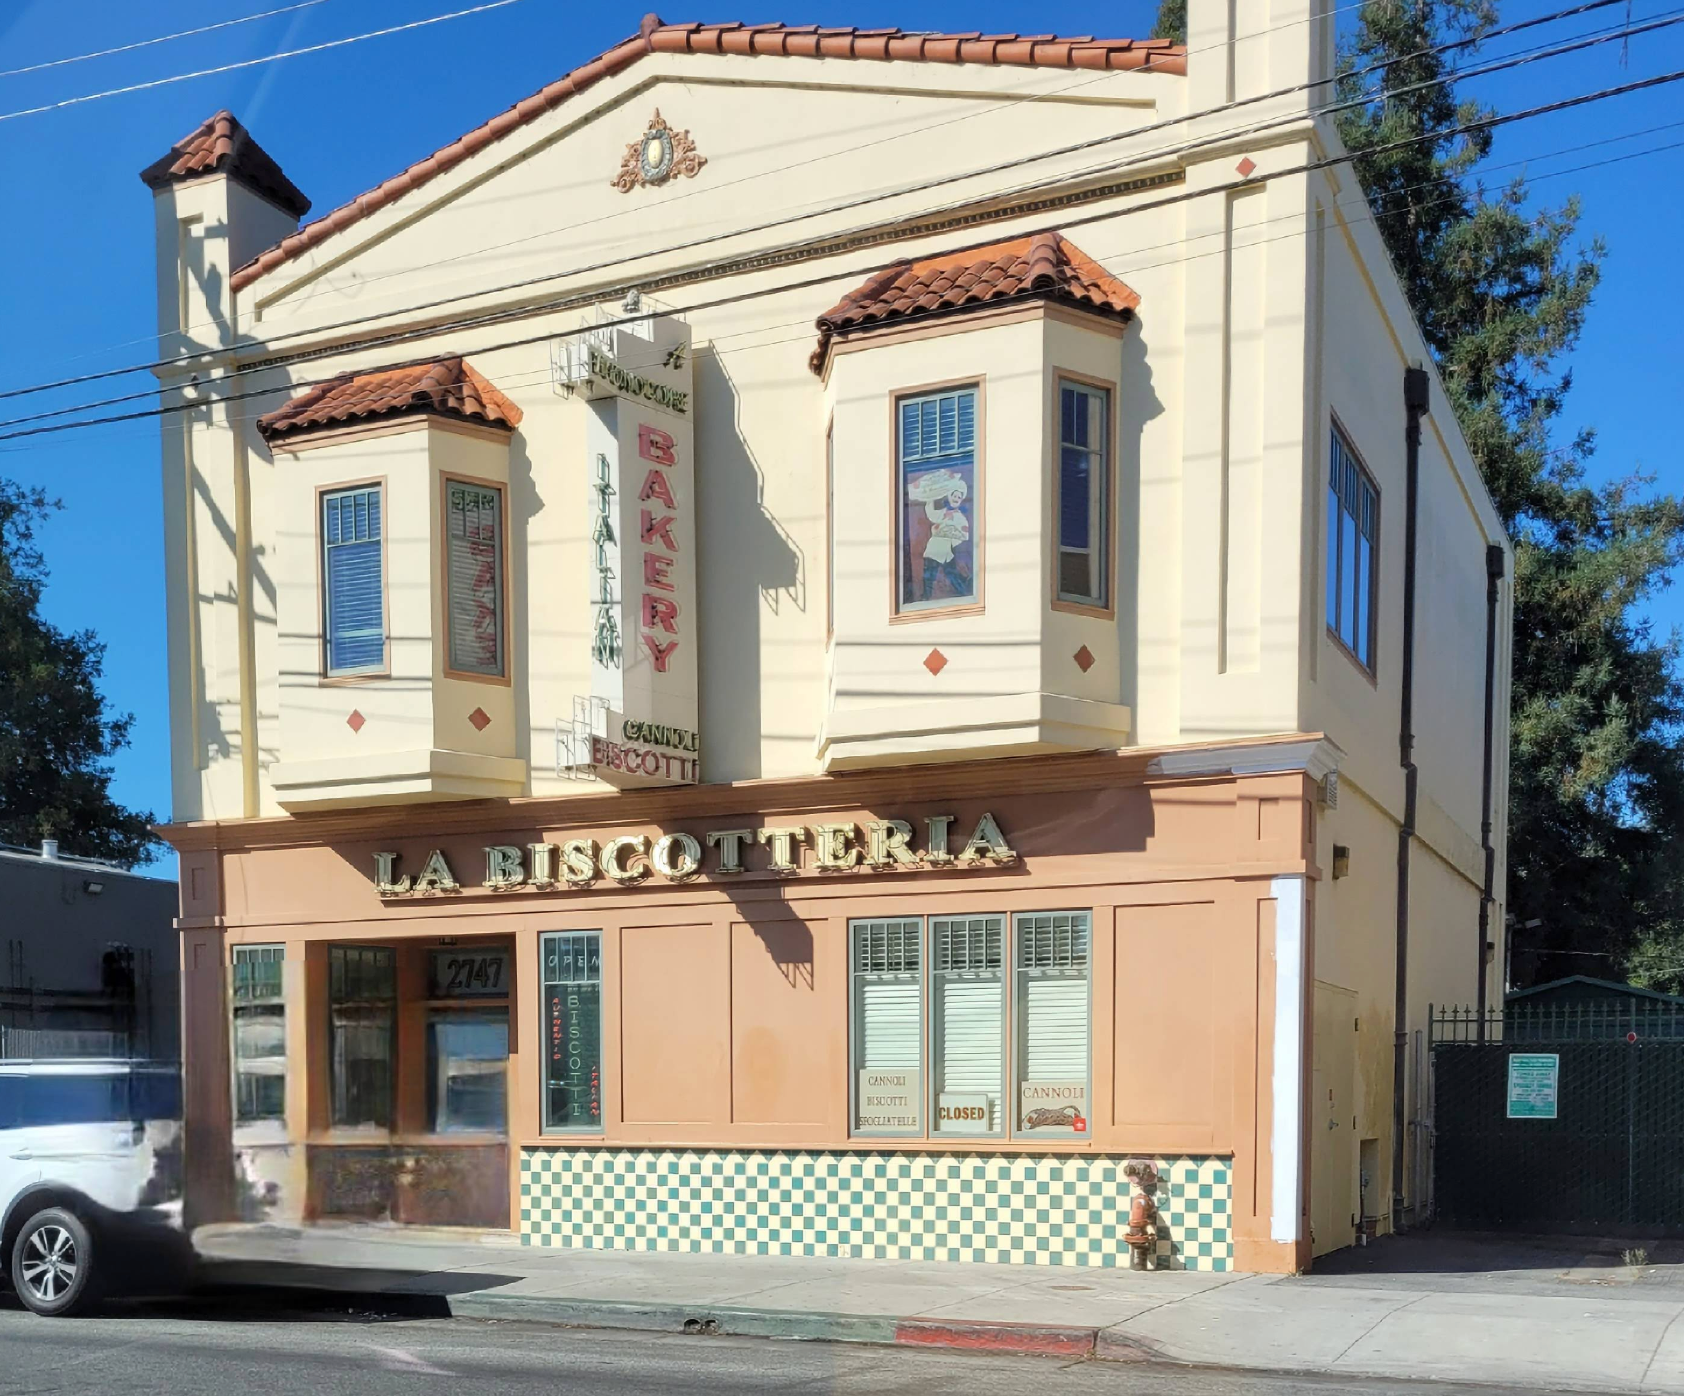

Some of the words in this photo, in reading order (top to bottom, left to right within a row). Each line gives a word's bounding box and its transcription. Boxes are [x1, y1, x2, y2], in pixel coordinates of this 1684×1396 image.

[638, 423, 680, 673] BAKERY
[622, 719, 699, 752] CANNOLI
[592, 737, 699, 782] BISCOTTI
[372, 850, 460, 896] LA
[481, 812, 1022, 890] BISCOTTERIA
[447, 956, 504, 989] 2747
[548, 955, 600, 968] OPEN
[567, 995, 582, 1116] BISCOTTI
[868, 1075, 906, 1086] CANNOLI
[1022, 1087, 1085, 1099] CANNOLI
[938, 1106, 986, 1121] CLOSED
